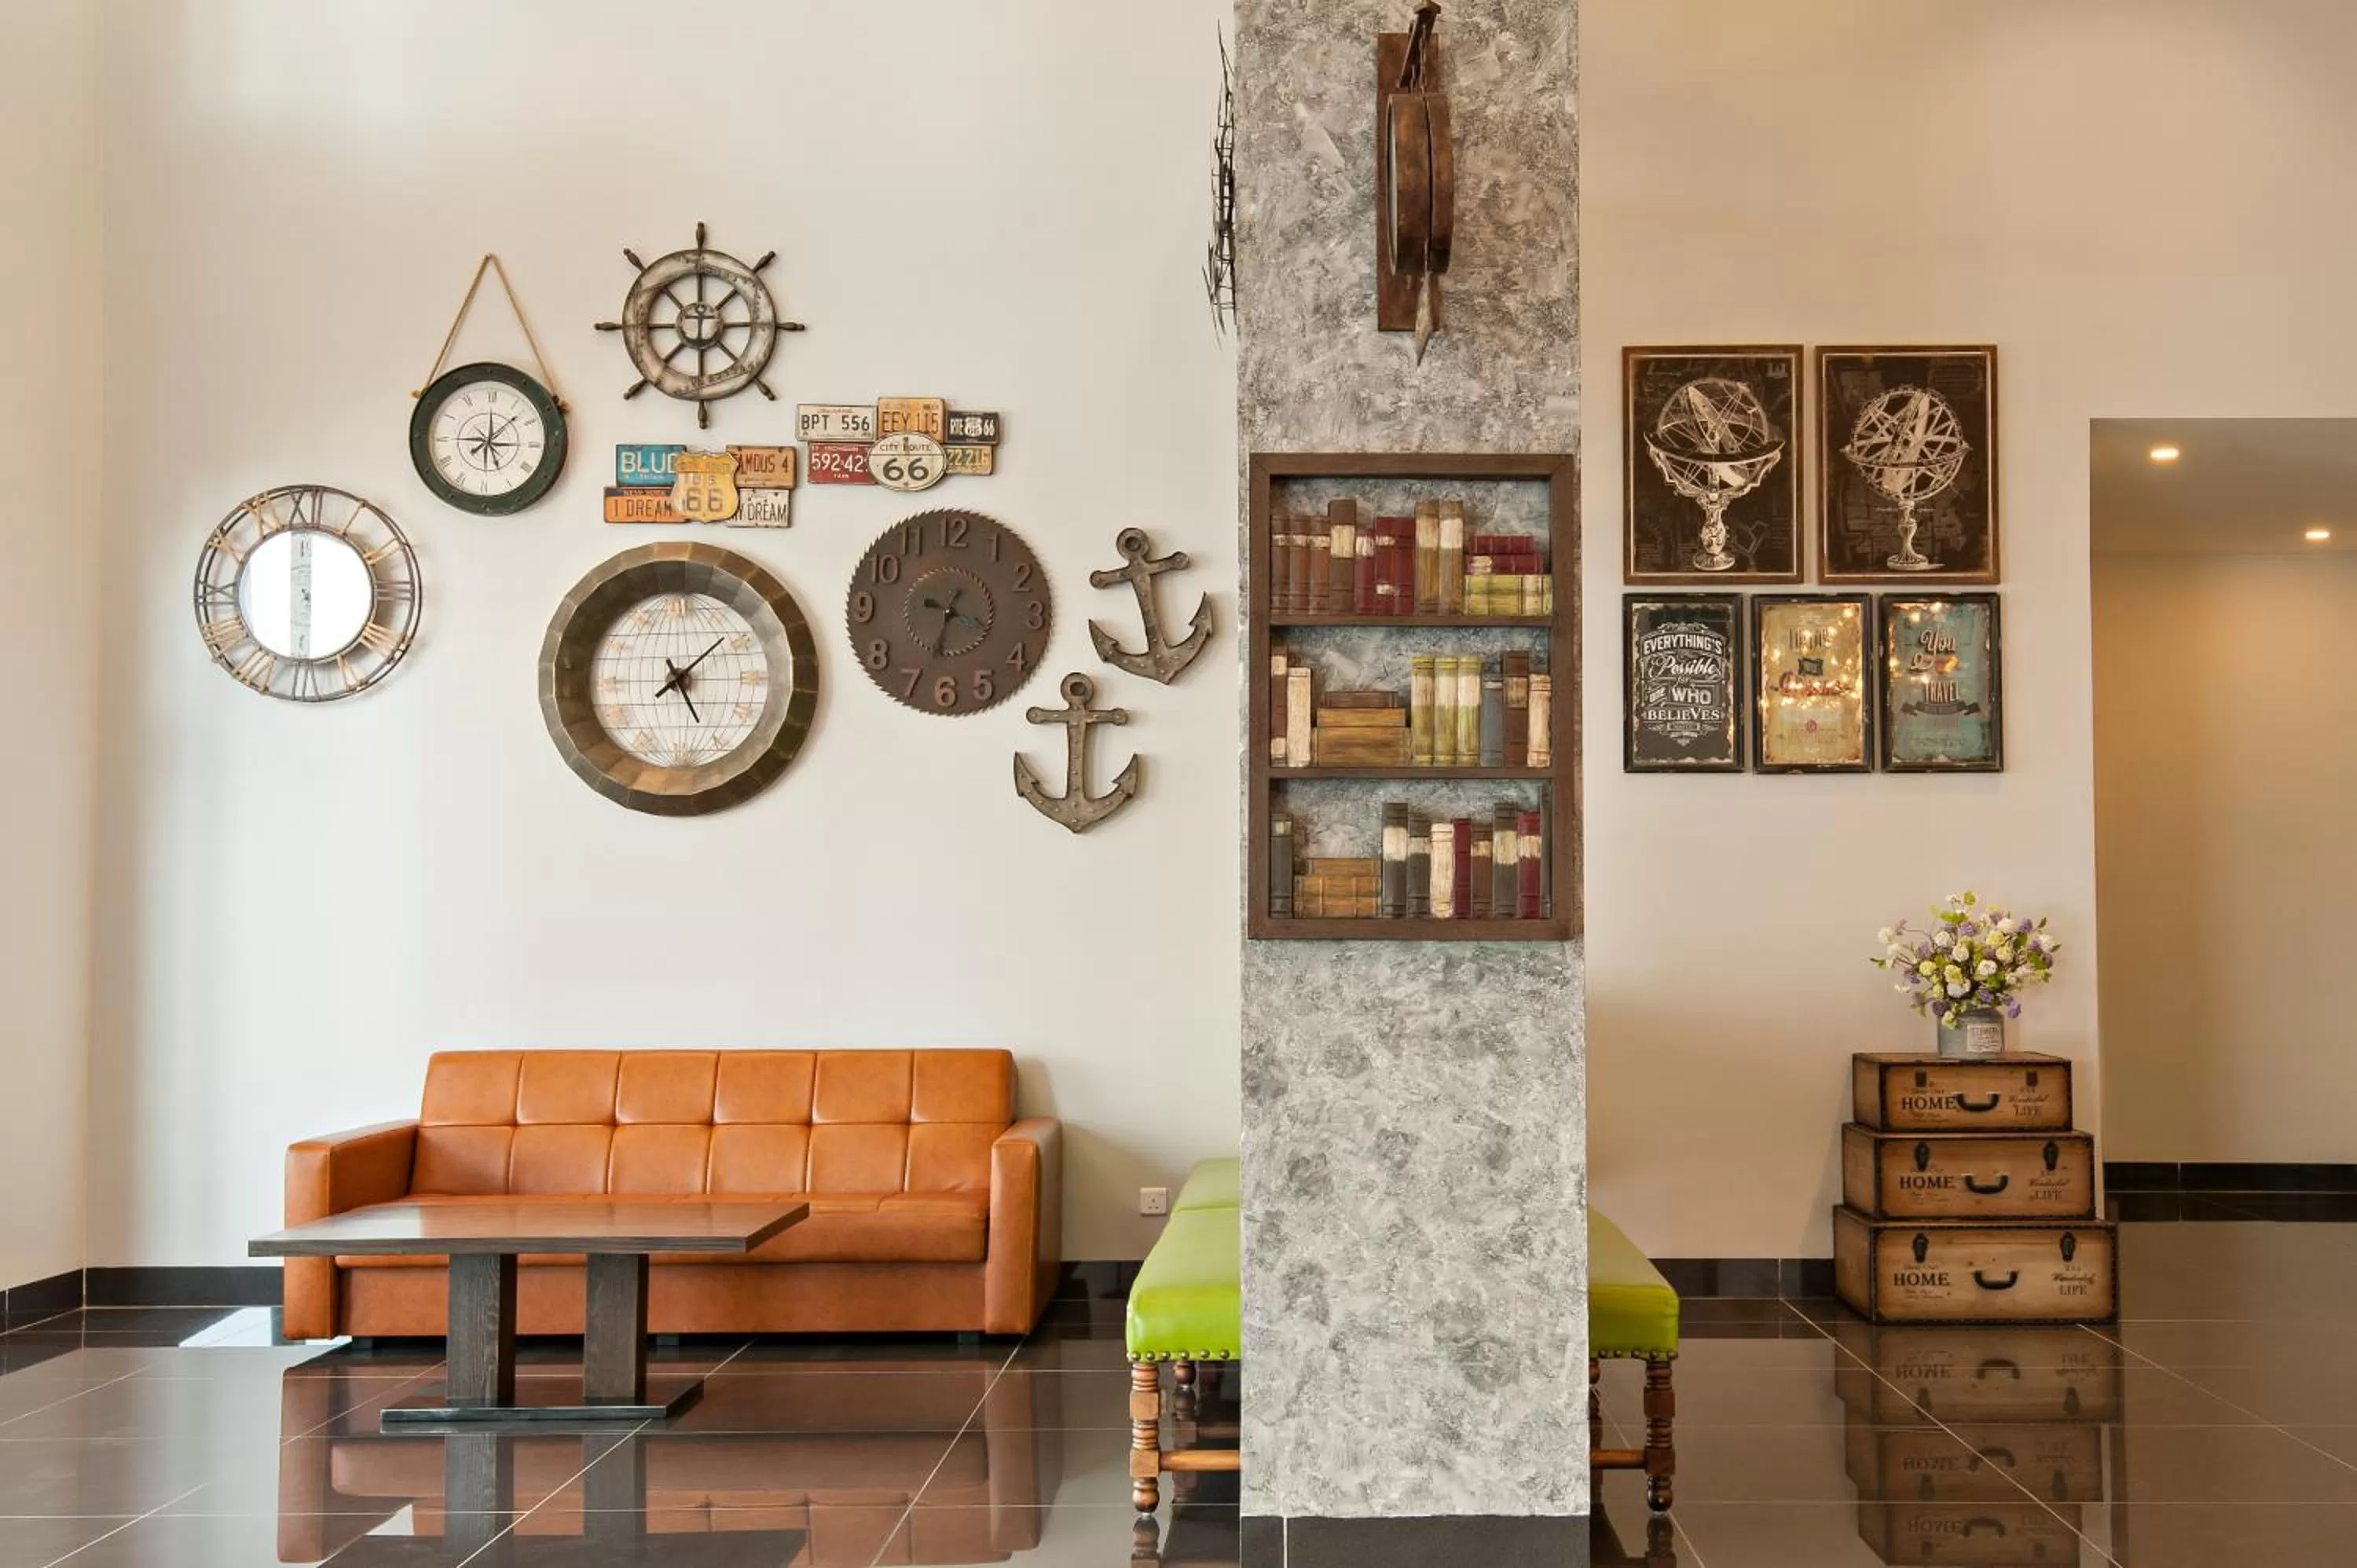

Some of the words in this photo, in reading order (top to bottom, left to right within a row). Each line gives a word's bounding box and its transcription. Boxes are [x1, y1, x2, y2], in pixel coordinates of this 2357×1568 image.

[801, 414, 830, 430] BPT
[841, 415, 870, 431] 556
[984, 419, 995, 436] 66
[879, 442, 898, 452] CITY
[904, 443, 931, 452] ROUTE
[782, 456, 788, 473] 4
[882, 457, 929, 482] 66
[626, 499, 673, 517] DREAM
[686, 487, 724, 512] 66
[747, 503, 786, 522] DREAM
[898, 526, 922, 556] 11
[940, 518, 969, 549] 12
[985, 532, 1000, 562] 1
[869, 553, 900, 584] 10
[1012, 562, 1032, 592] 2
[853, 592, 874, 622] 9
[1027, 601, 1044, 629] 3
[867, 639, 889, 669] 8
[1644, 634, 1723, 654] EVERYTHING'S
[1919, 628, 1956, 655] You
[1006, 641, 1028, 671] 4
[1648, 655, 1721, 678] Possible
[901, 669, 923, 698] 7
[934, 676, 957, 707] 6
[973, 669, 994, 701] 5
[1672, 687, 1712, 705] WHO
[1648, 708, 1720, 720] BELIEVES
[1902, 1097, 1956, 1110] HOME
[1900, 1176, 1956, 1189] HOME
[1893, 1273, 1950, 1286] HOME
[2059, 1284, 2087, 1295] LIFE
